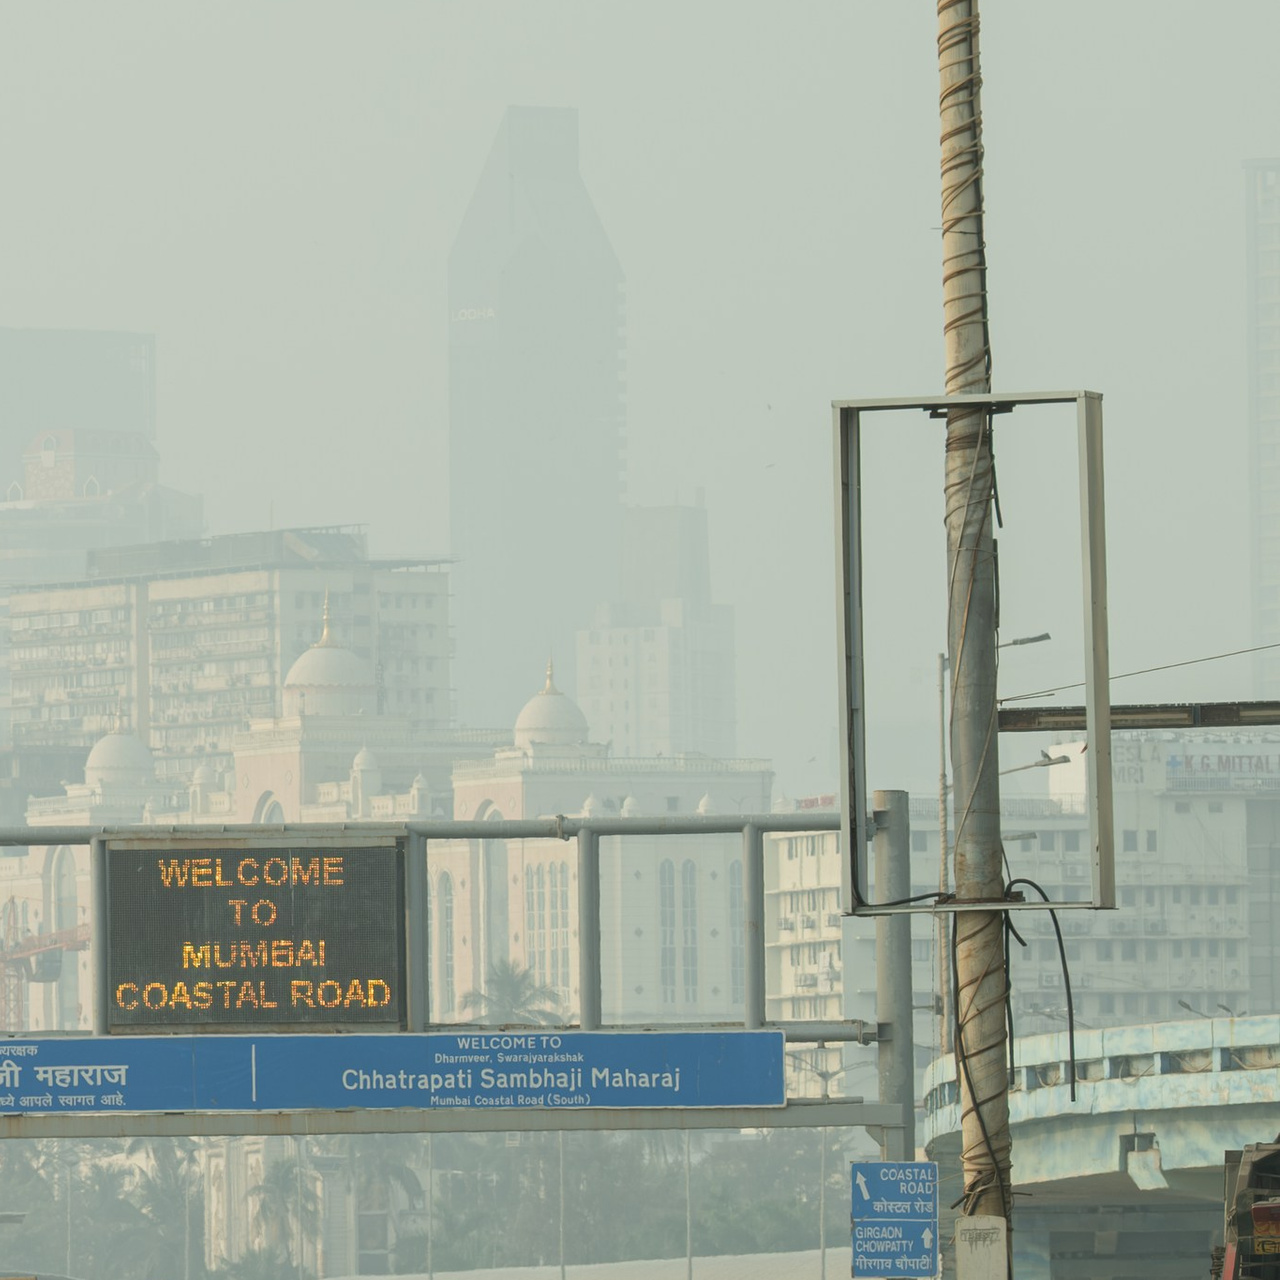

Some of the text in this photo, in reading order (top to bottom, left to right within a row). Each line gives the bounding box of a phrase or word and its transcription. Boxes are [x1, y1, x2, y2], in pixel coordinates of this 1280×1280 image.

[1113, 745, 1161, 763] ESLA
[1217, 755, 1274, 773] MITTAL
[158, 857, 344, 887] WELCOME
[228, 899, 277, 926] TO
[182, 940, 325, 968] MUMBAI
[116, 979, 391, 1010] COASTAL ROAD
[457, 1036, 562, 1050] WELCOME TO
[434, 1052, 584, 1064] Dharmveer, Swarajyarakshak
[33, 1065, 129, 1088] महाराज
[342, 1067, 680, 1093] Chhatrapati Sambhaji Maharaj
[20, 1093, 53, 1107] आपले
[58, 1095, 95, 1107] स्वागत
[100, 1091, 126, 1106] आहे.
[430, 1093, 591, 1106] Mumbai Coastal Road (South)
[880, 1168, 933, 1181] COASTAL
[900, 1182, 933, 1194] ROAD
[873, 1197, 933, 1213] कोस्टल रोड
[855, 1227, 903, 1238] GIRGAON
[855, 1240, 914, 1252] CHOWPATTY
